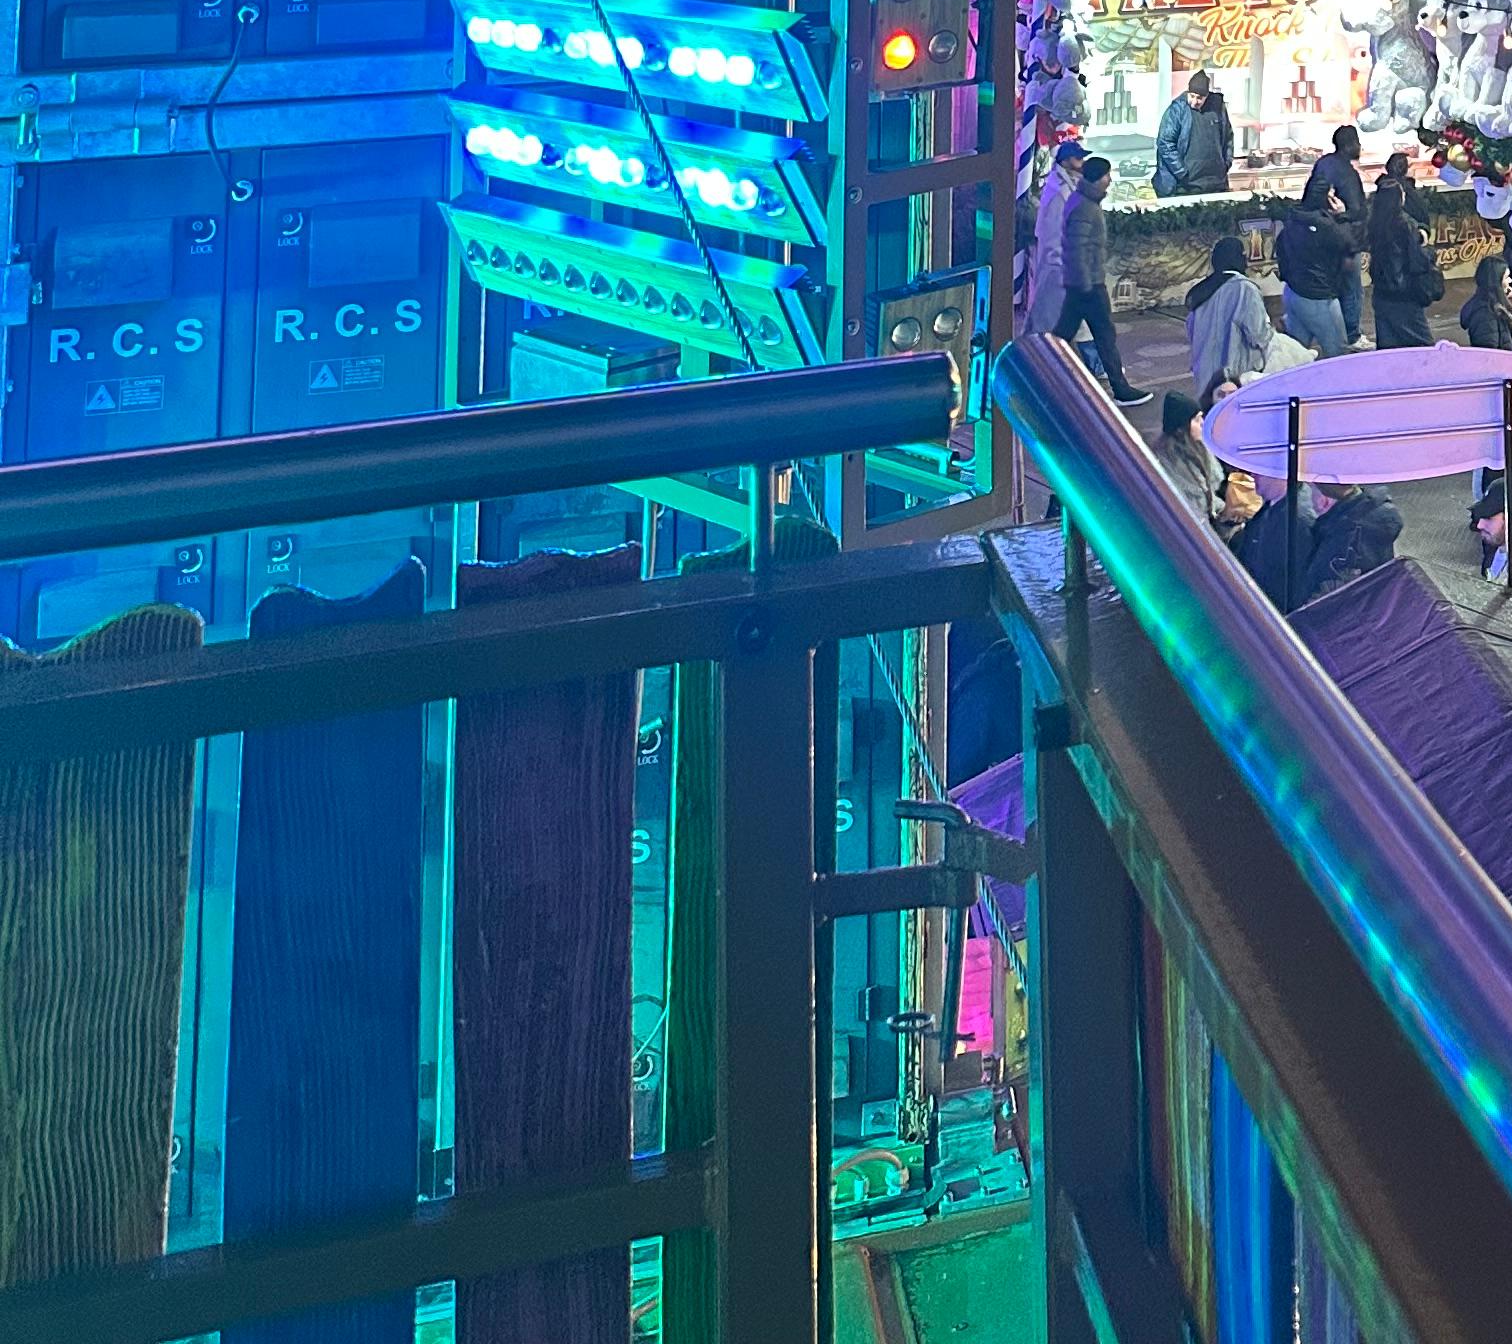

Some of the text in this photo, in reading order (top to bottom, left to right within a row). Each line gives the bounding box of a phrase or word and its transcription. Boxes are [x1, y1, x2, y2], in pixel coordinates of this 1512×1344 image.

[1200, 6, 1305, 46] Knock
[266, 564, 290, 574] LOCK
[176, 576, 200, 585] LOCK
